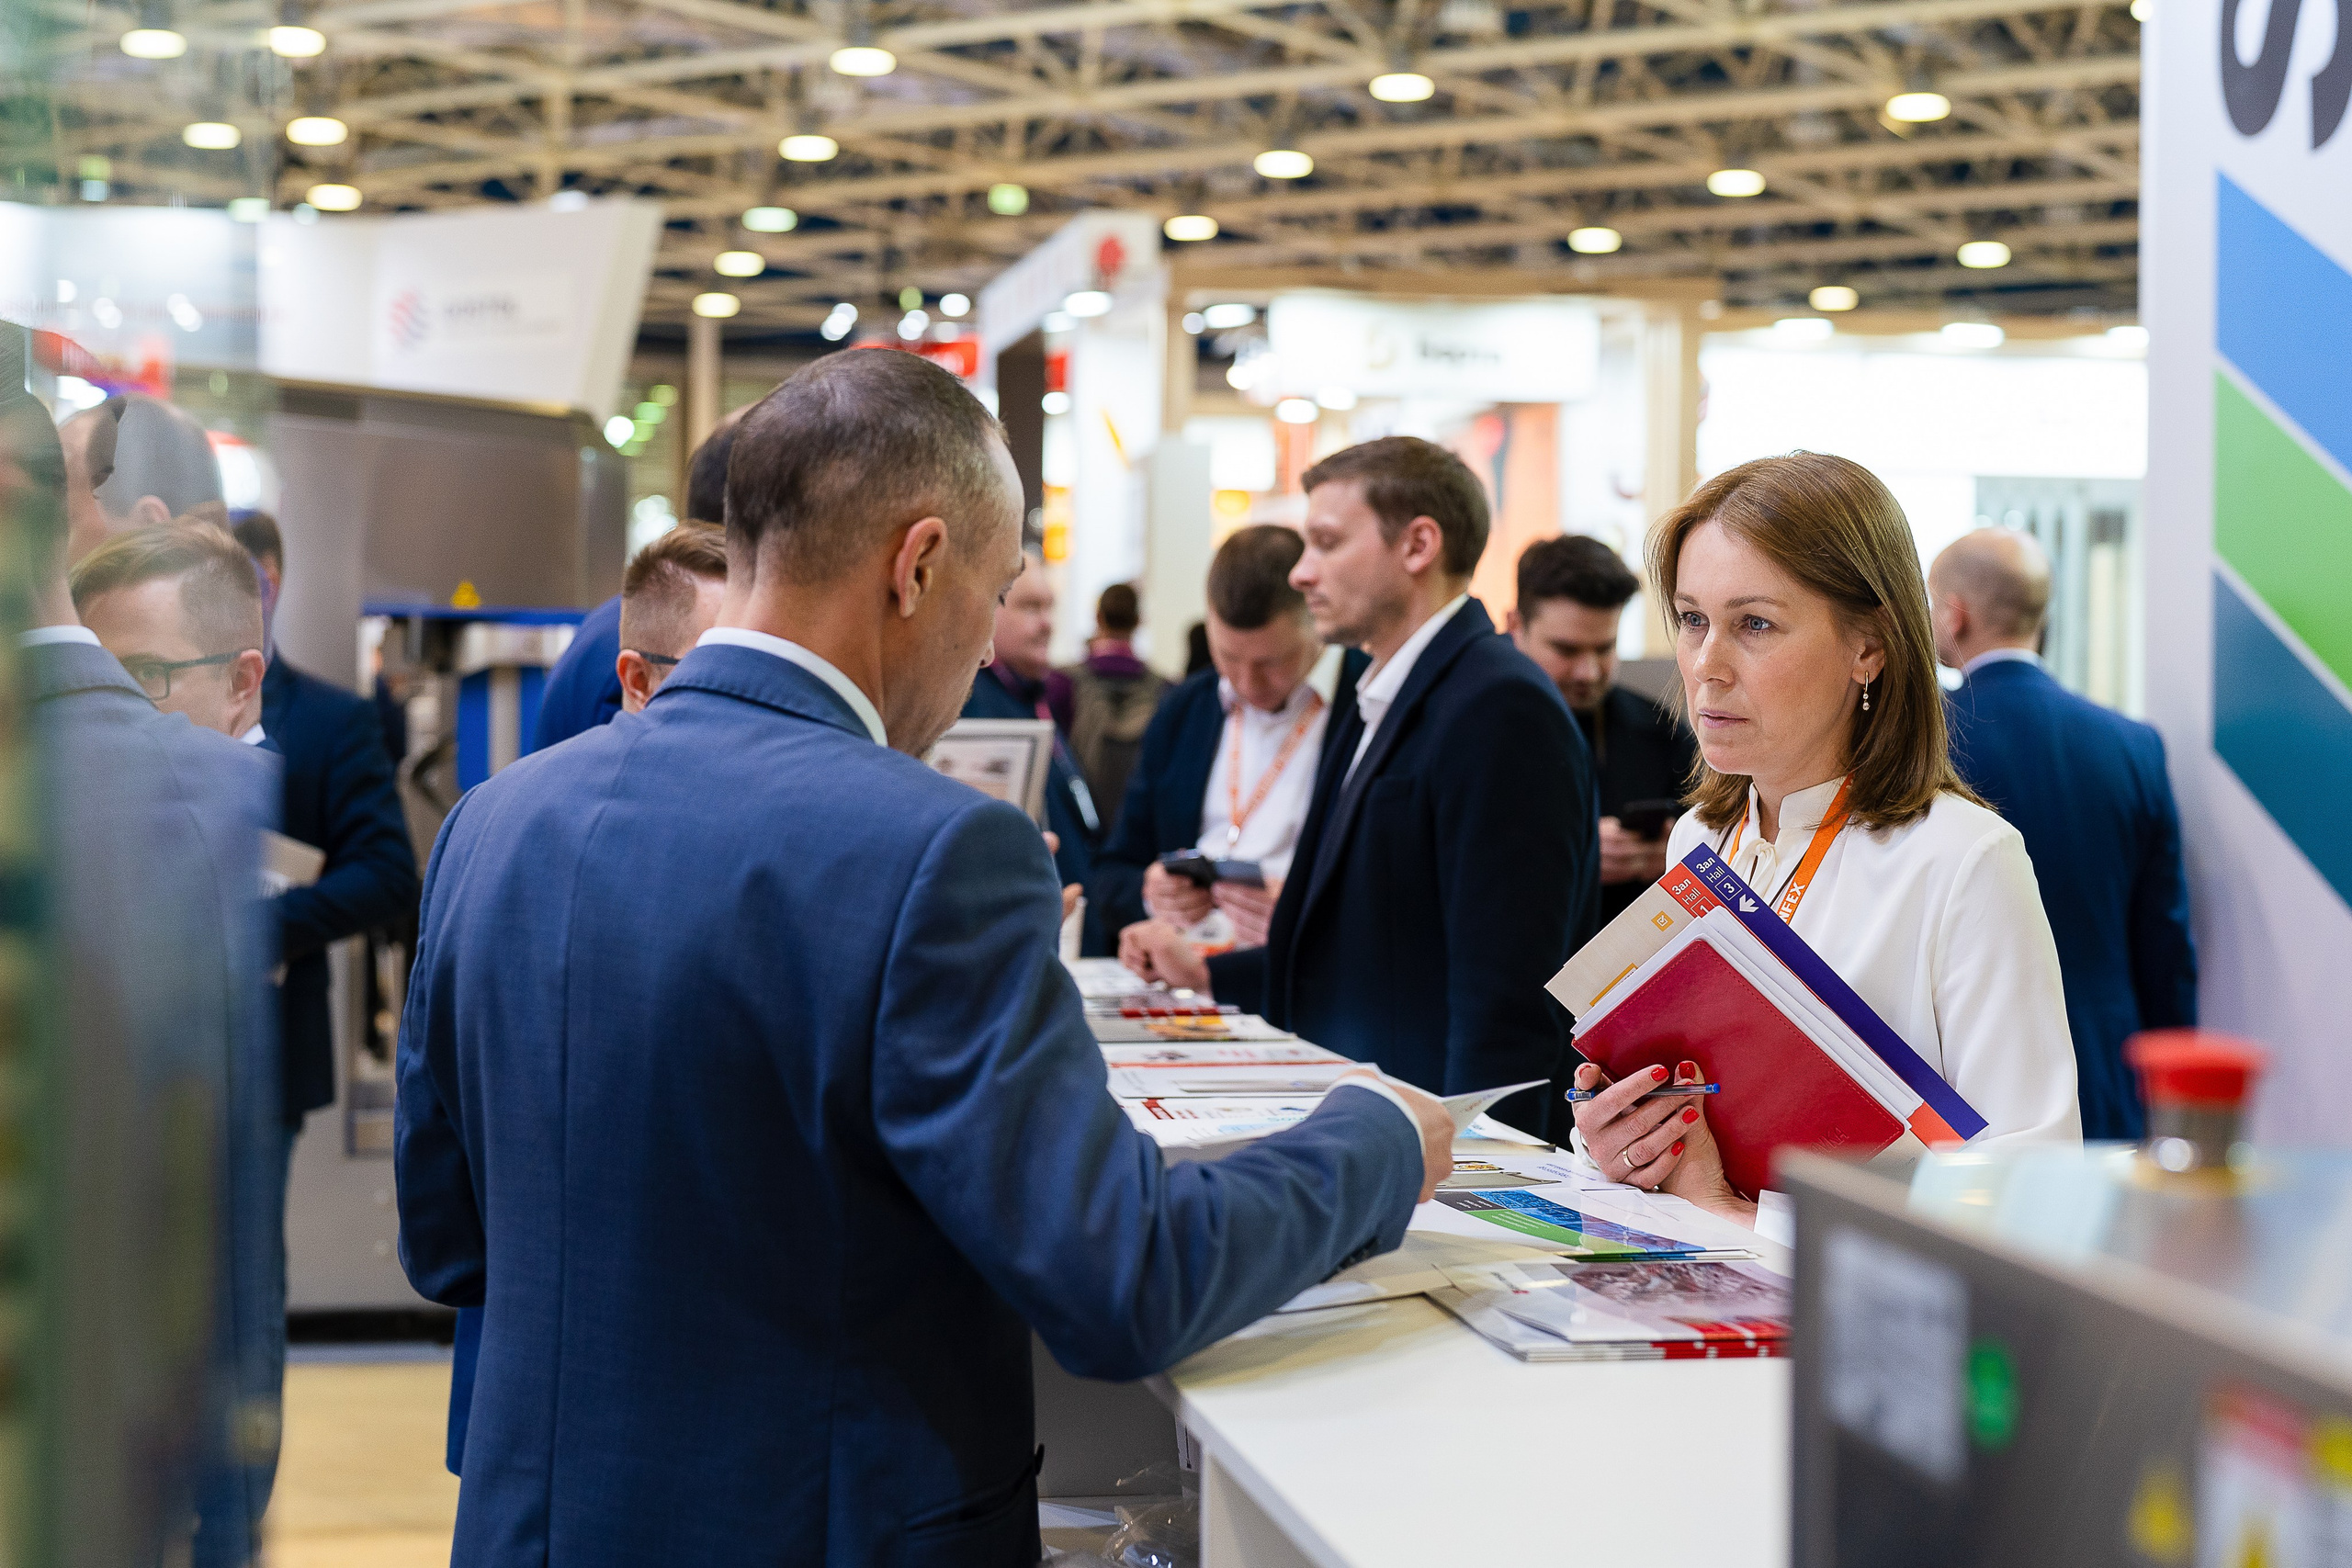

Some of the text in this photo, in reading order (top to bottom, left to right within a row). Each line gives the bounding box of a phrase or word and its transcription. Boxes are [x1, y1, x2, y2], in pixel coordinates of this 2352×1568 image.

[1695, 857, 1716, 874] Зал
[1705, 865, 1725, 884] Hall
[1671, 878, 1692, 896] Зал
[1723, 882, 1736, 894] 3
[1681, 886, 1702, 906] Hall
[1699, 904, 1710, 914] 1
